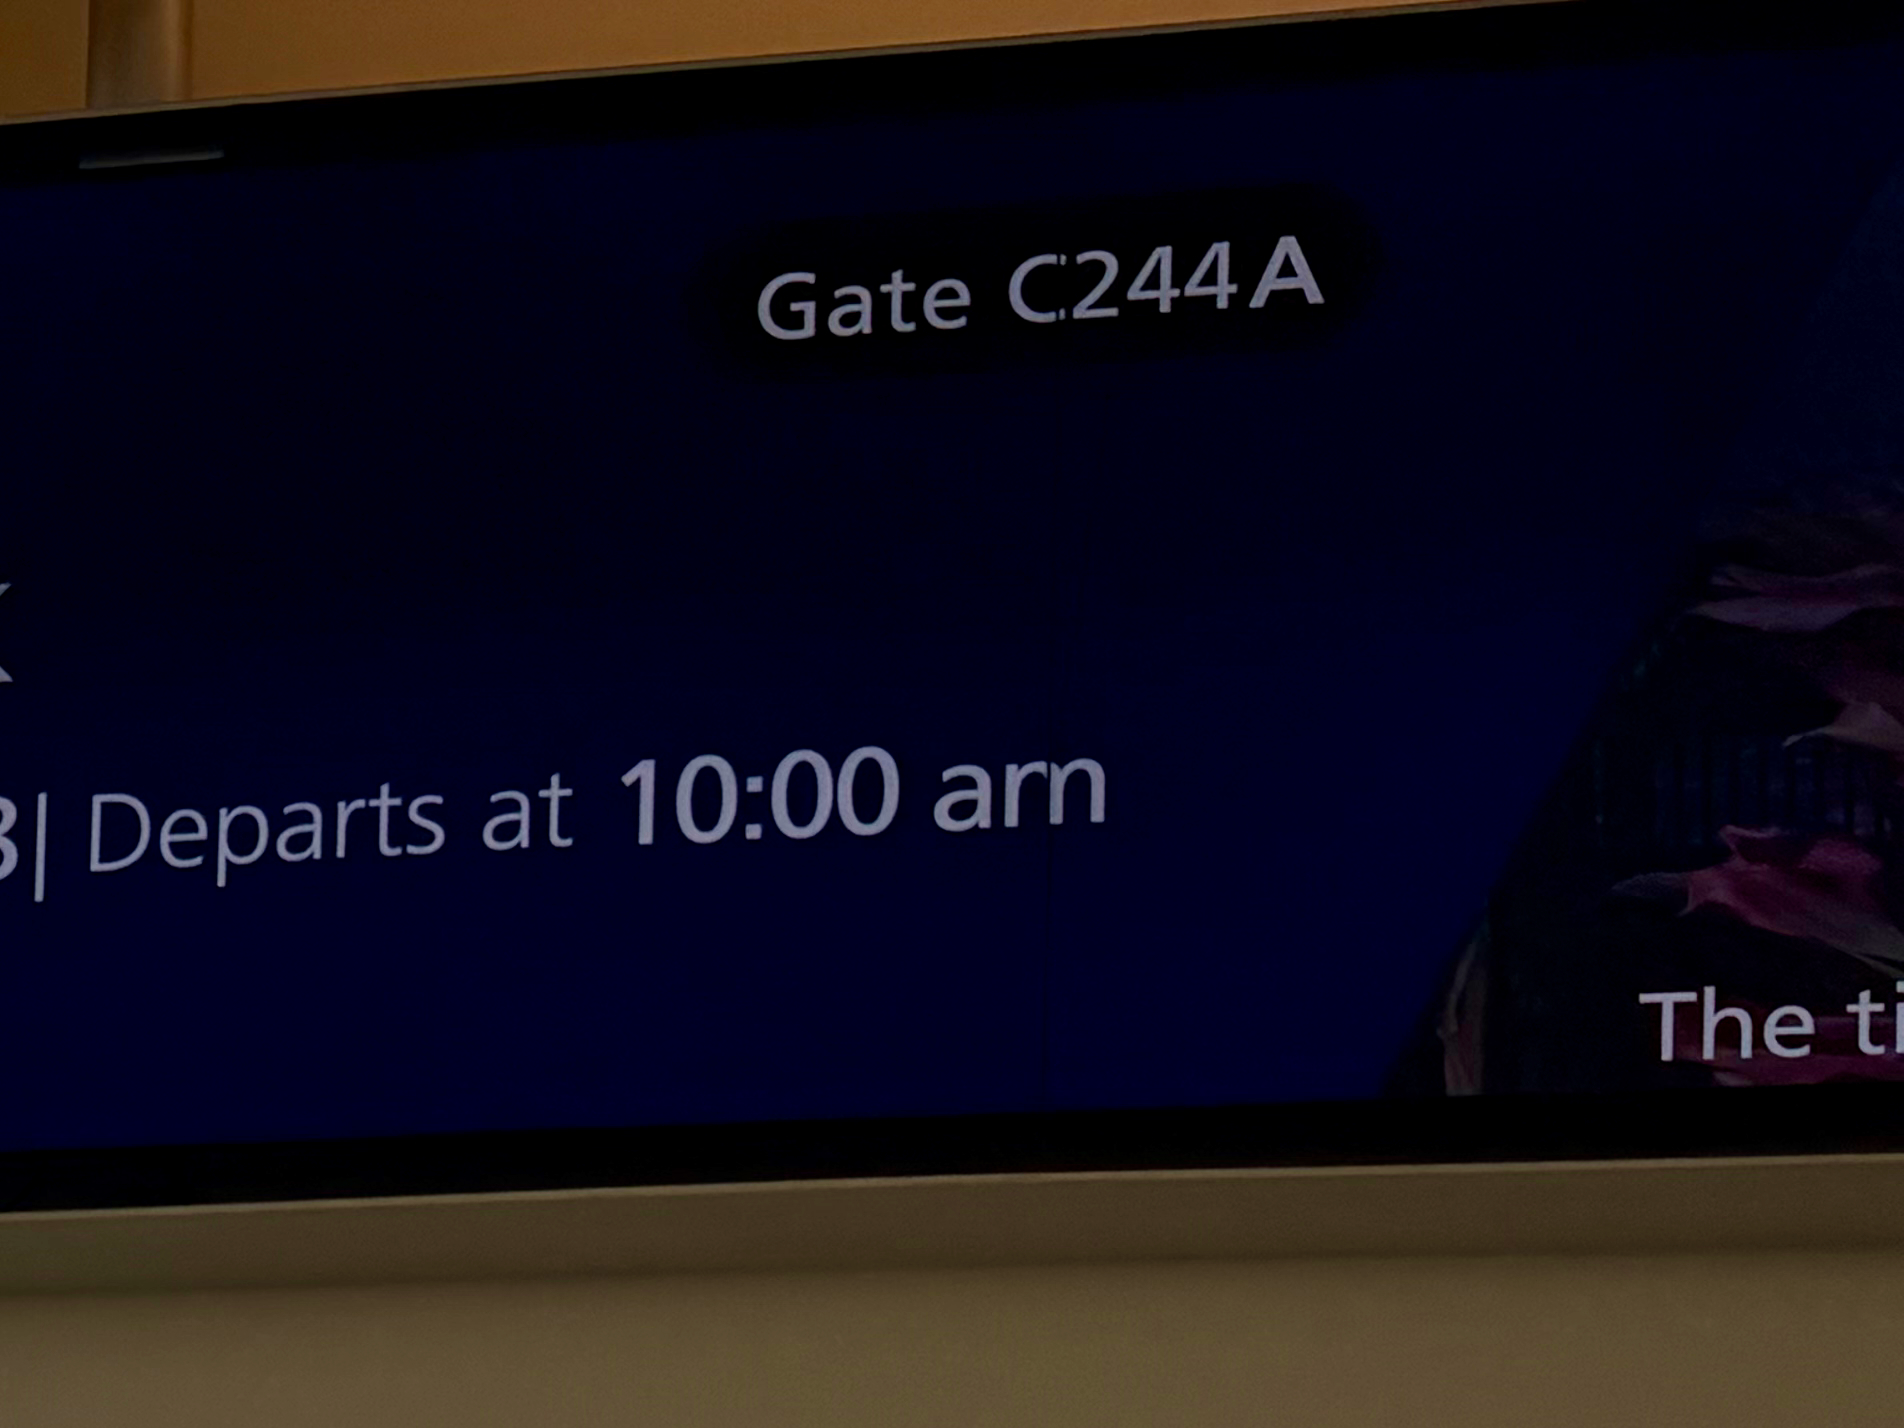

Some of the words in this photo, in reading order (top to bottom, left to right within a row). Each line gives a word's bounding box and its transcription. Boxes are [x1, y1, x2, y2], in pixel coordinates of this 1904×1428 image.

[758, 270, 971, 340] Gate
[1009, 236, 1324, 323] C244A
[90, 783, 445, 887] Departs
[483, 774, 573, 850] at
[622, 746, 899, 844] 10:00
[1639, 986, 1815, 1062] The
